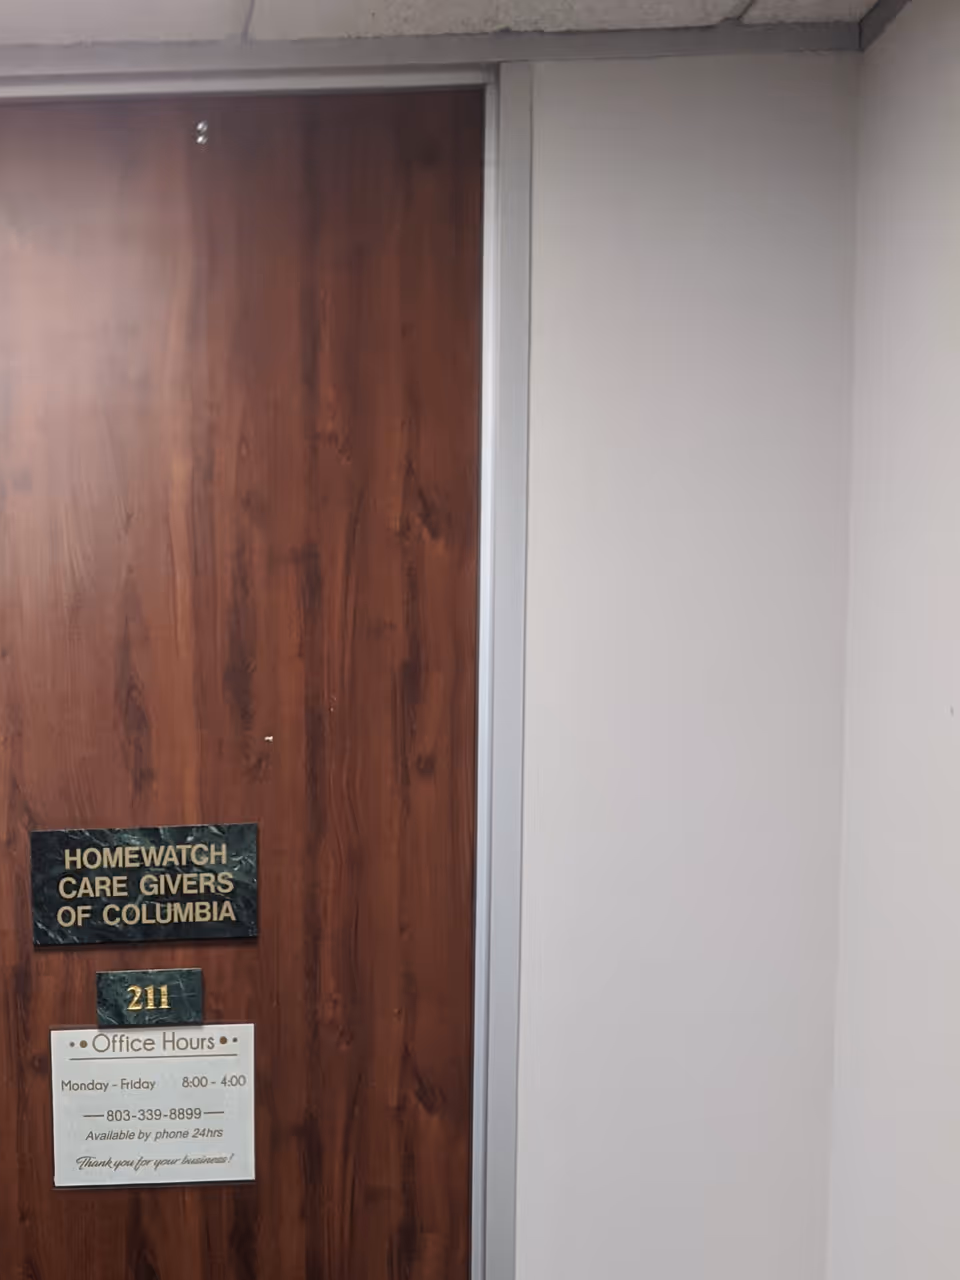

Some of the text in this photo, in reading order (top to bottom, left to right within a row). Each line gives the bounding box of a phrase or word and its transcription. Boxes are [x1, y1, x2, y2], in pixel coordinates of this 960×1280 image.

[64, 843, 228, 870] HOMEWATCH
[58, 871, 235, 899] CARE GIVERS
[56, 900, 237, 928] OF COLUMBIA
[126, 984, 172, 1011] 211
[92, 1031, 215, 1053] Office Hours
[61, 1079, 109, 1092] Monday
[120, 1078, 156, 1091] Friday
[182, 1076, 208, 1089] 8:00
[220, 1074, 246, 1088] 4:00
[106, 1107, 202, 1122] 803-339-8899
[85, 1128, 223, 1142] Available by phone 24hrs
[76, 1155, 113, 1171] Thank
[113, 1159, 134, 1171] you
[134, 1157, 150, 1172] for
[153, 1158, 180, 1171] your
